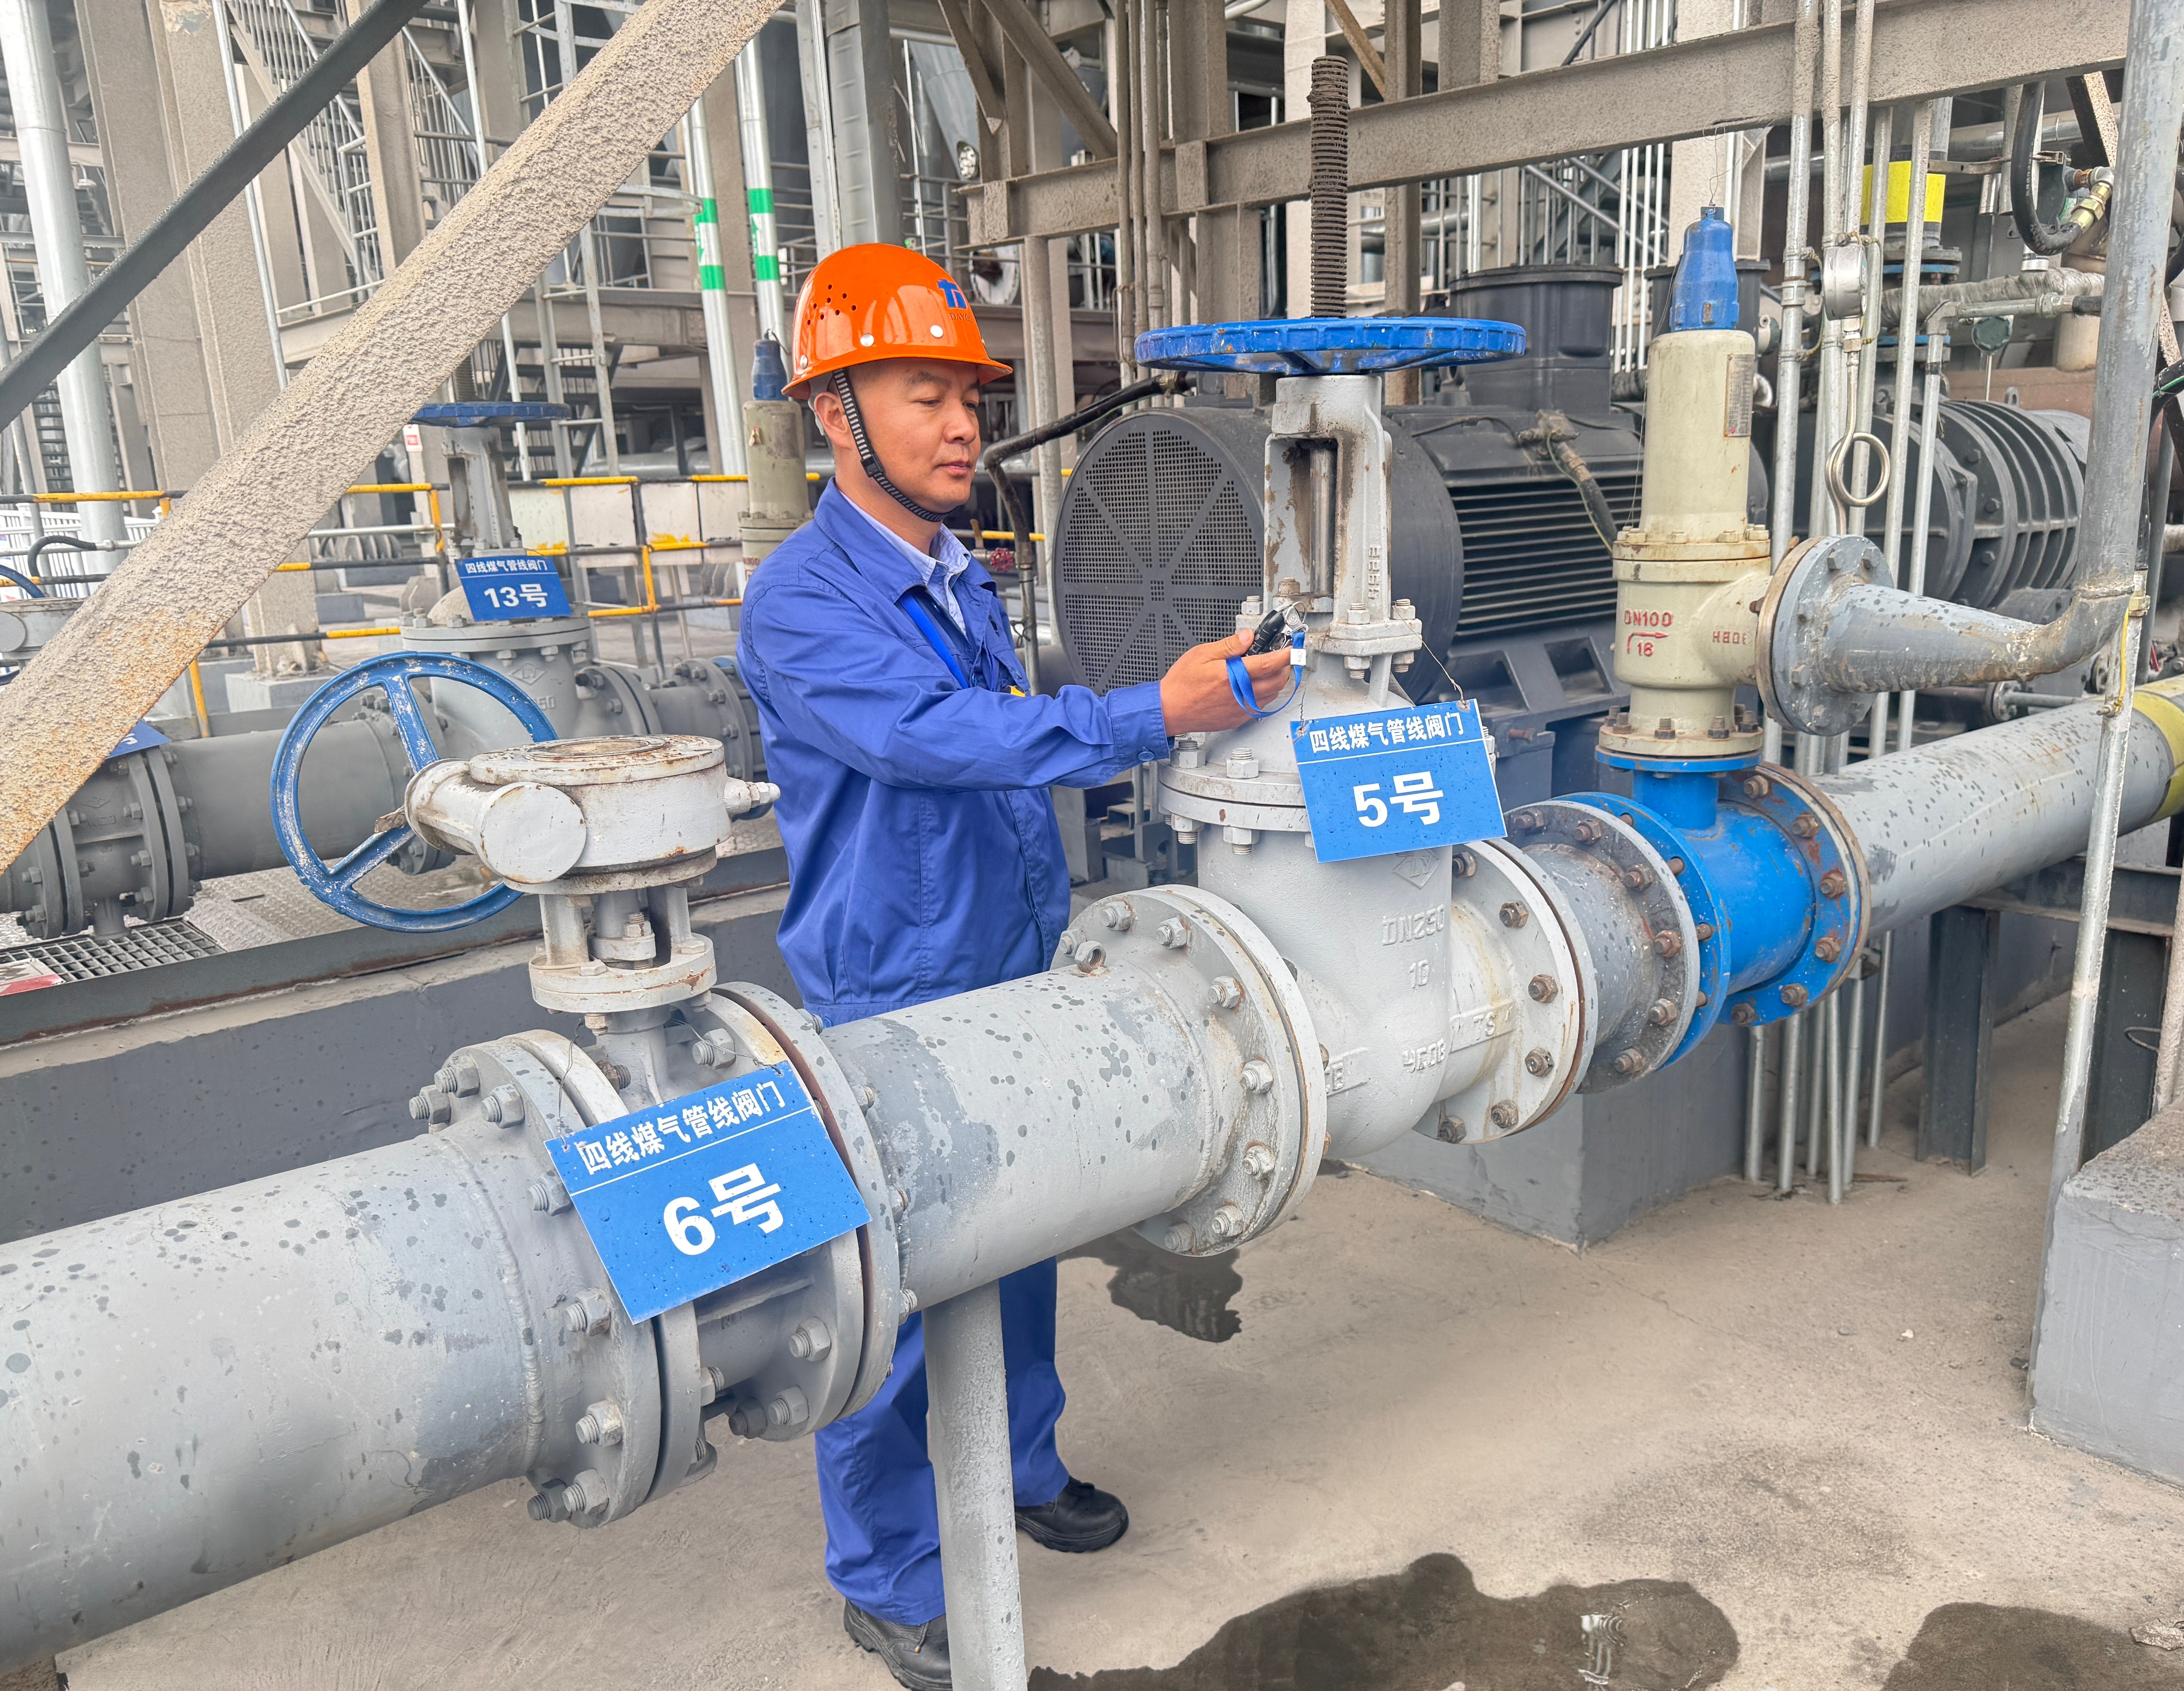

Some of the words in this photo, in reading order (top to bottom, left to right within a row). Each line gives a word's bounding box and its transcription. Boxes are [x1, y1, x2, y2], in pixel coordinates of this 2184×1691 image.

[465, 559, 548, 574] 四线煤气管线阀门
[484, 584, 548, 608] 13号
[1624, 610, 1673, 626] DN100
[1310, 712, 1464, 753] 四线煤气管线阀门
[1353, 771, 1444, 828] 5号
[1382, 904, 1445, 946] DN250
[577, 1081, 785, 1175] 四线煤气管线阀门
[663, 1163, 784, 1255] 6号
